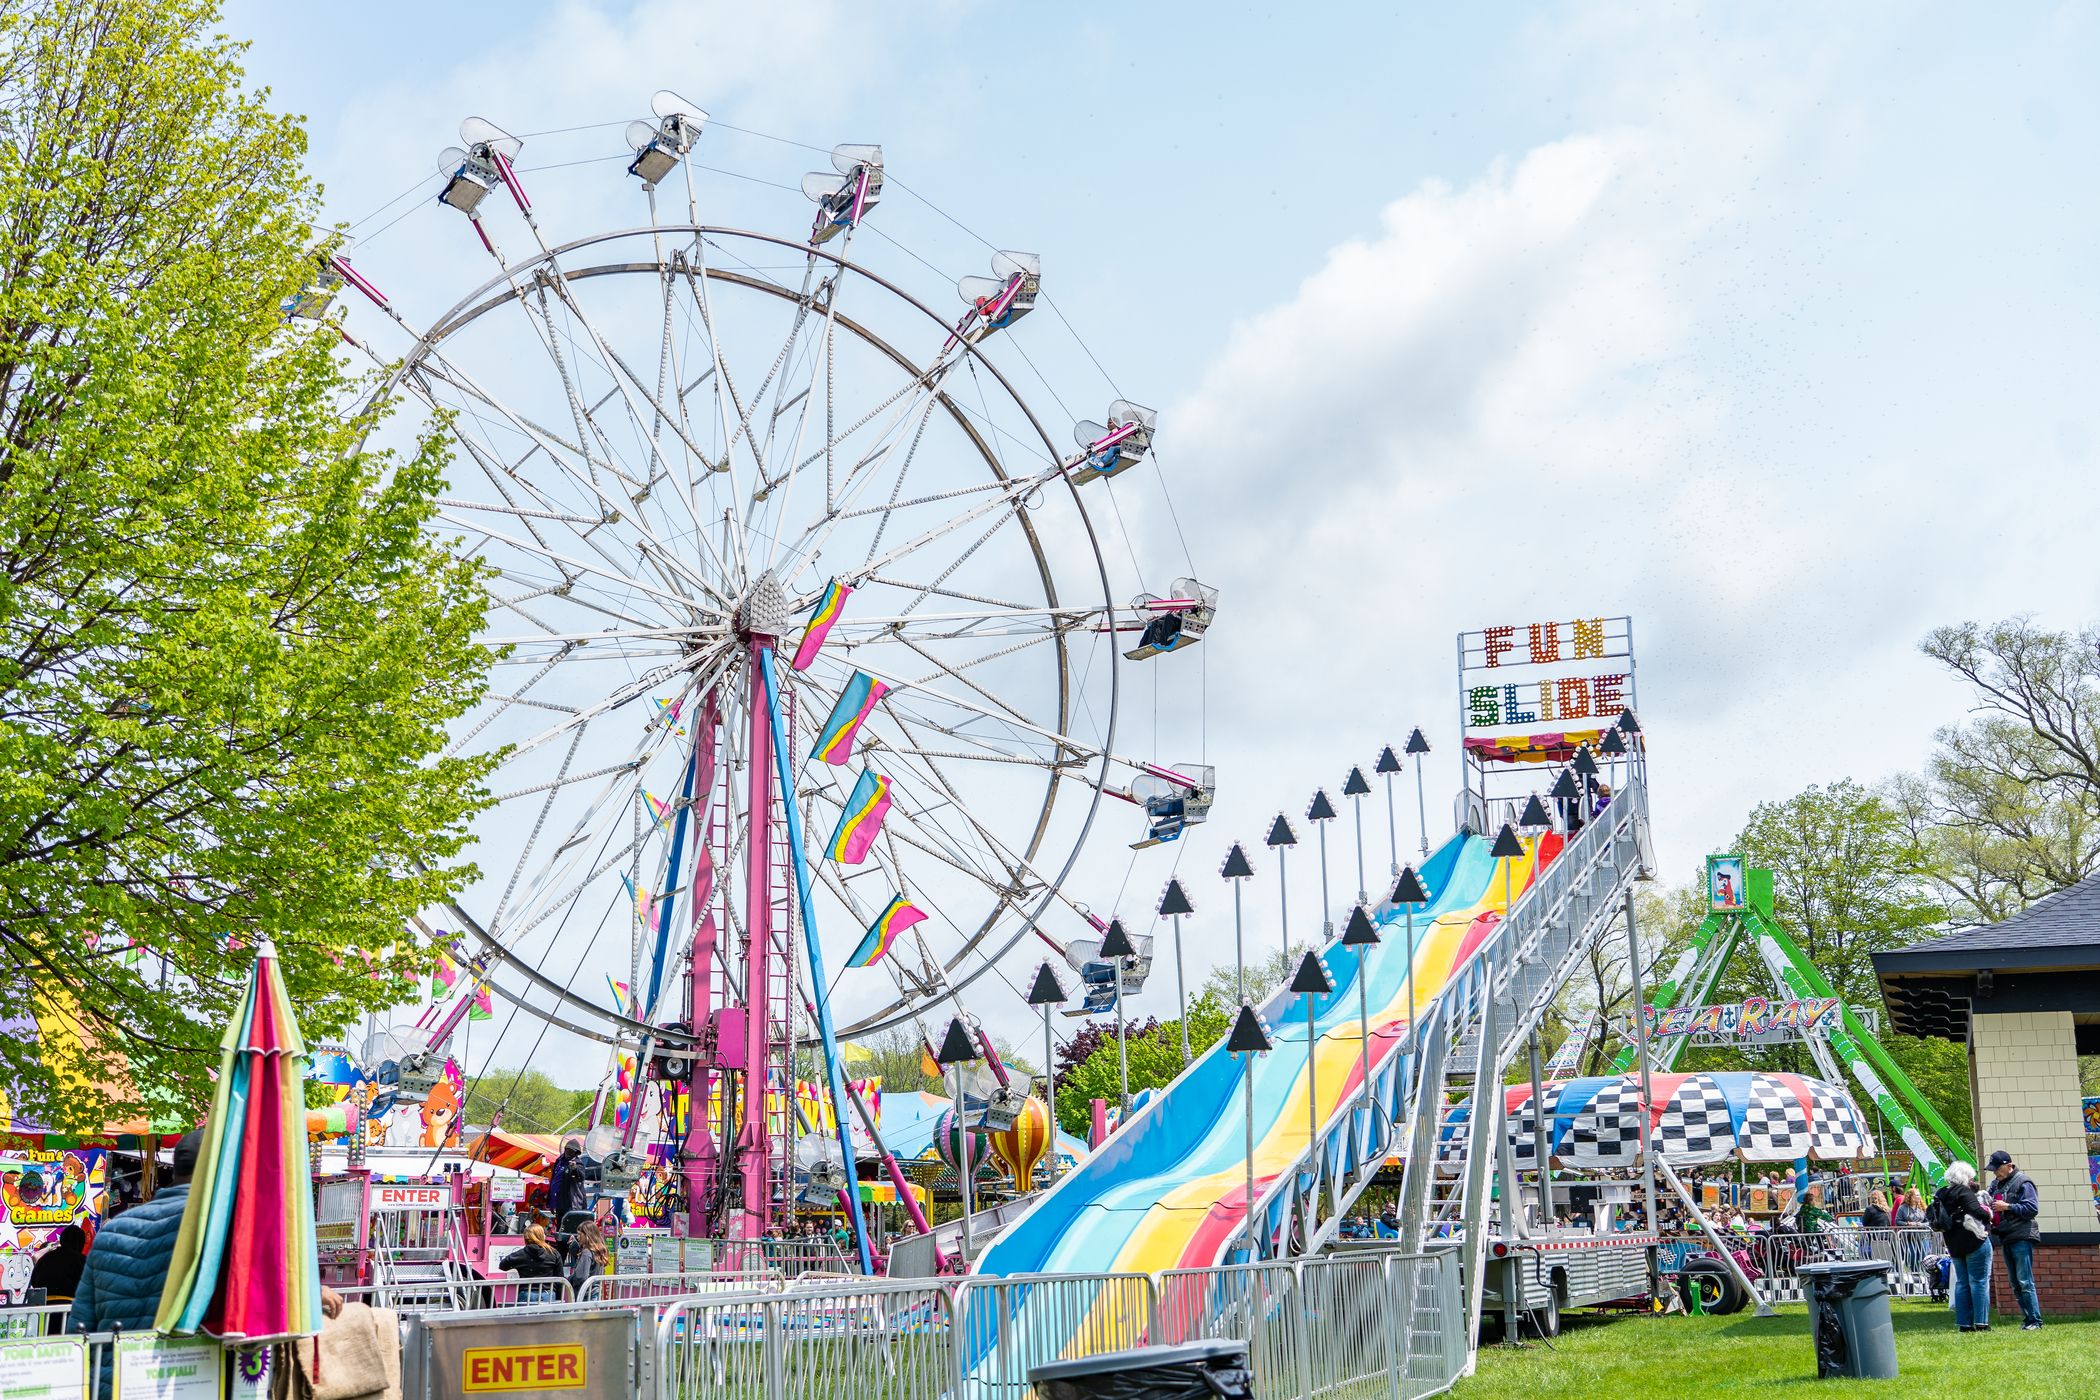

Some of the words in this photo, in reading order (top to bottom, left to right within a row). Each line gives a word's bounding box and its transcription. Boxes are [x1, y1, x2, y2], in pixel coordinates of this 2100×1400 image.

[1485, 616, 1604, 668] FUN
[1470, 673, 1624, 727] SLIDE
[1625, 1004, 1725, 1044] SEA
[1736, 996, 1839, 1037] RAY
[28, 1149, 55, 1162] Fun
[56, 1150, 64, 1162] &
[382, 1190, 440, 1202] ENTER
[11, 1206, 73, 1223] Games
[471, 1353, 579, 1384] ENTER
